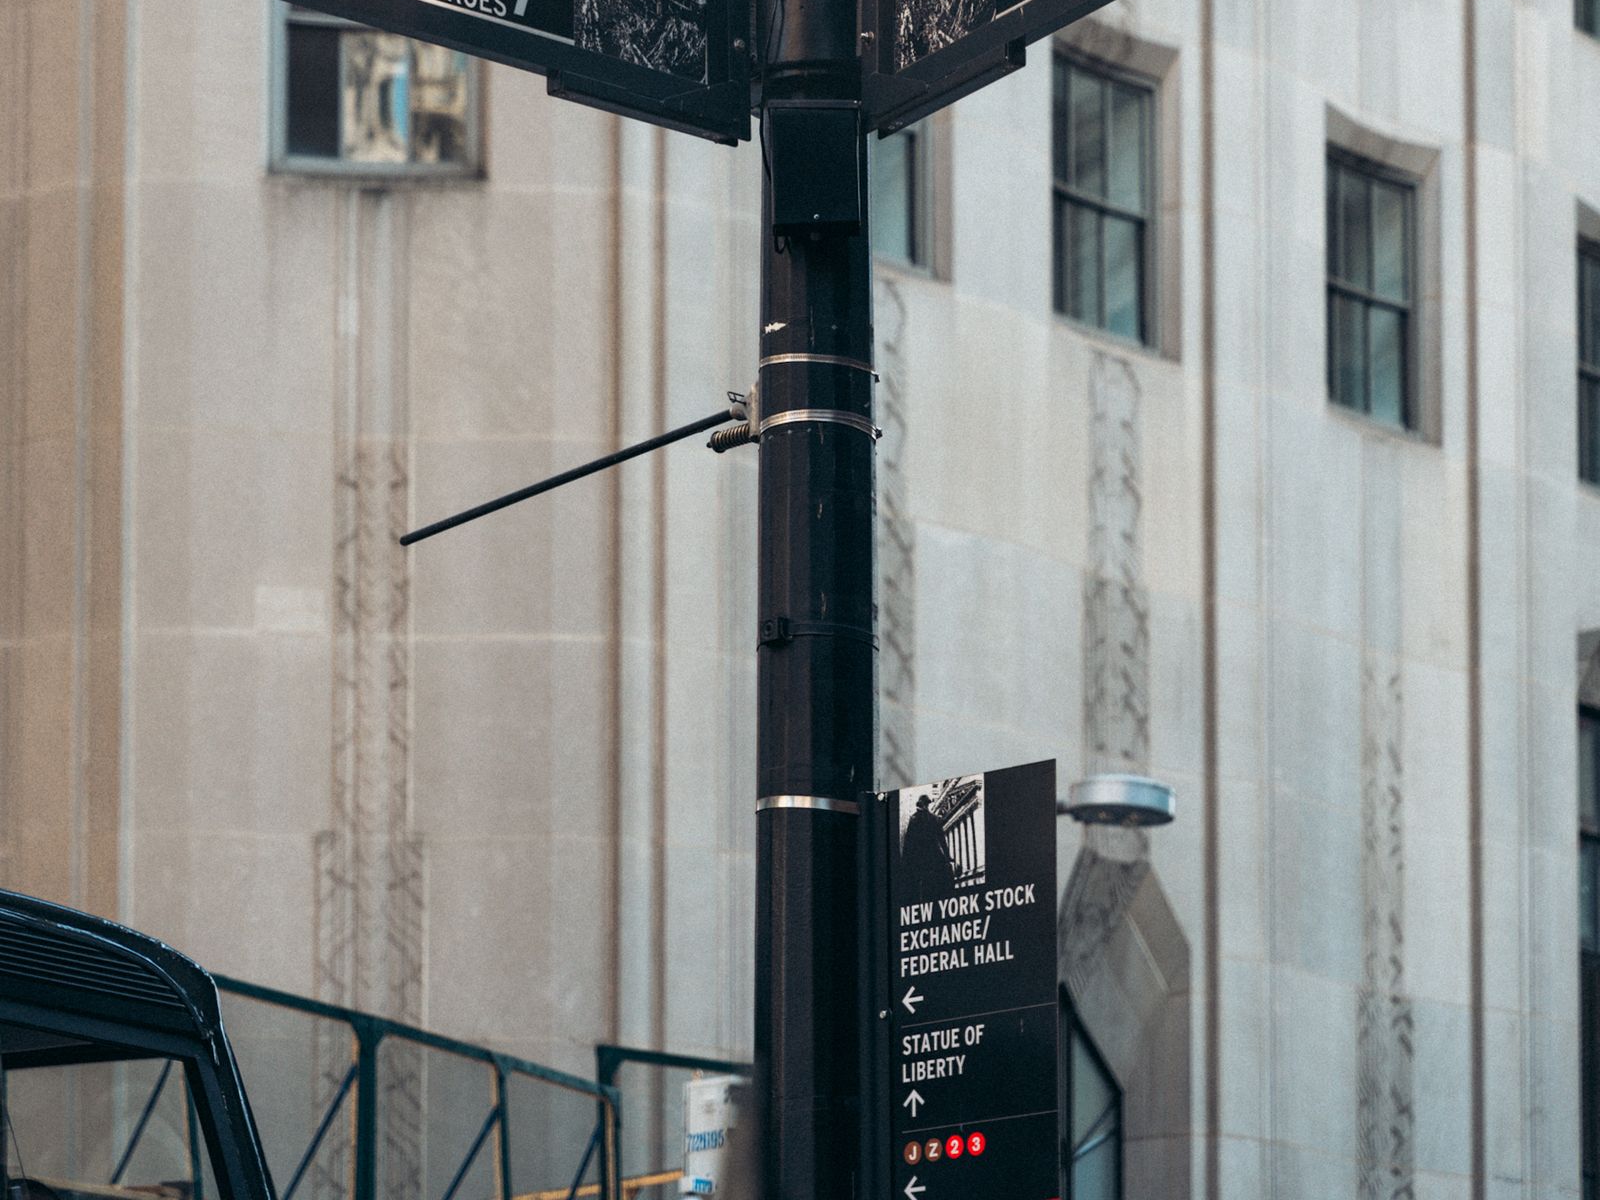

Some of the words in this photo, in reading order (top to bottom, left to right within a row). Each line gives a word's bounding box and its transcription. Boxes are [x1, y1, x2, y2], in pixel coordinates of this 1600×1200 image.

[900, 902, 934, 927] NEW
[938, 893, 980, 919] YORK
[984, 883, 1036, 911] STOCK
[900, 914, 991, 952] EXCHANGE/
[900, 947, 969, 978] FEDERAL
[974, 940, 1015, 966] HALL
[902, 1027, 960, 1056] STATUE
[964, 1023, 986, 1047] OF
[902, 1054, 967, 1084] LIBERTY
